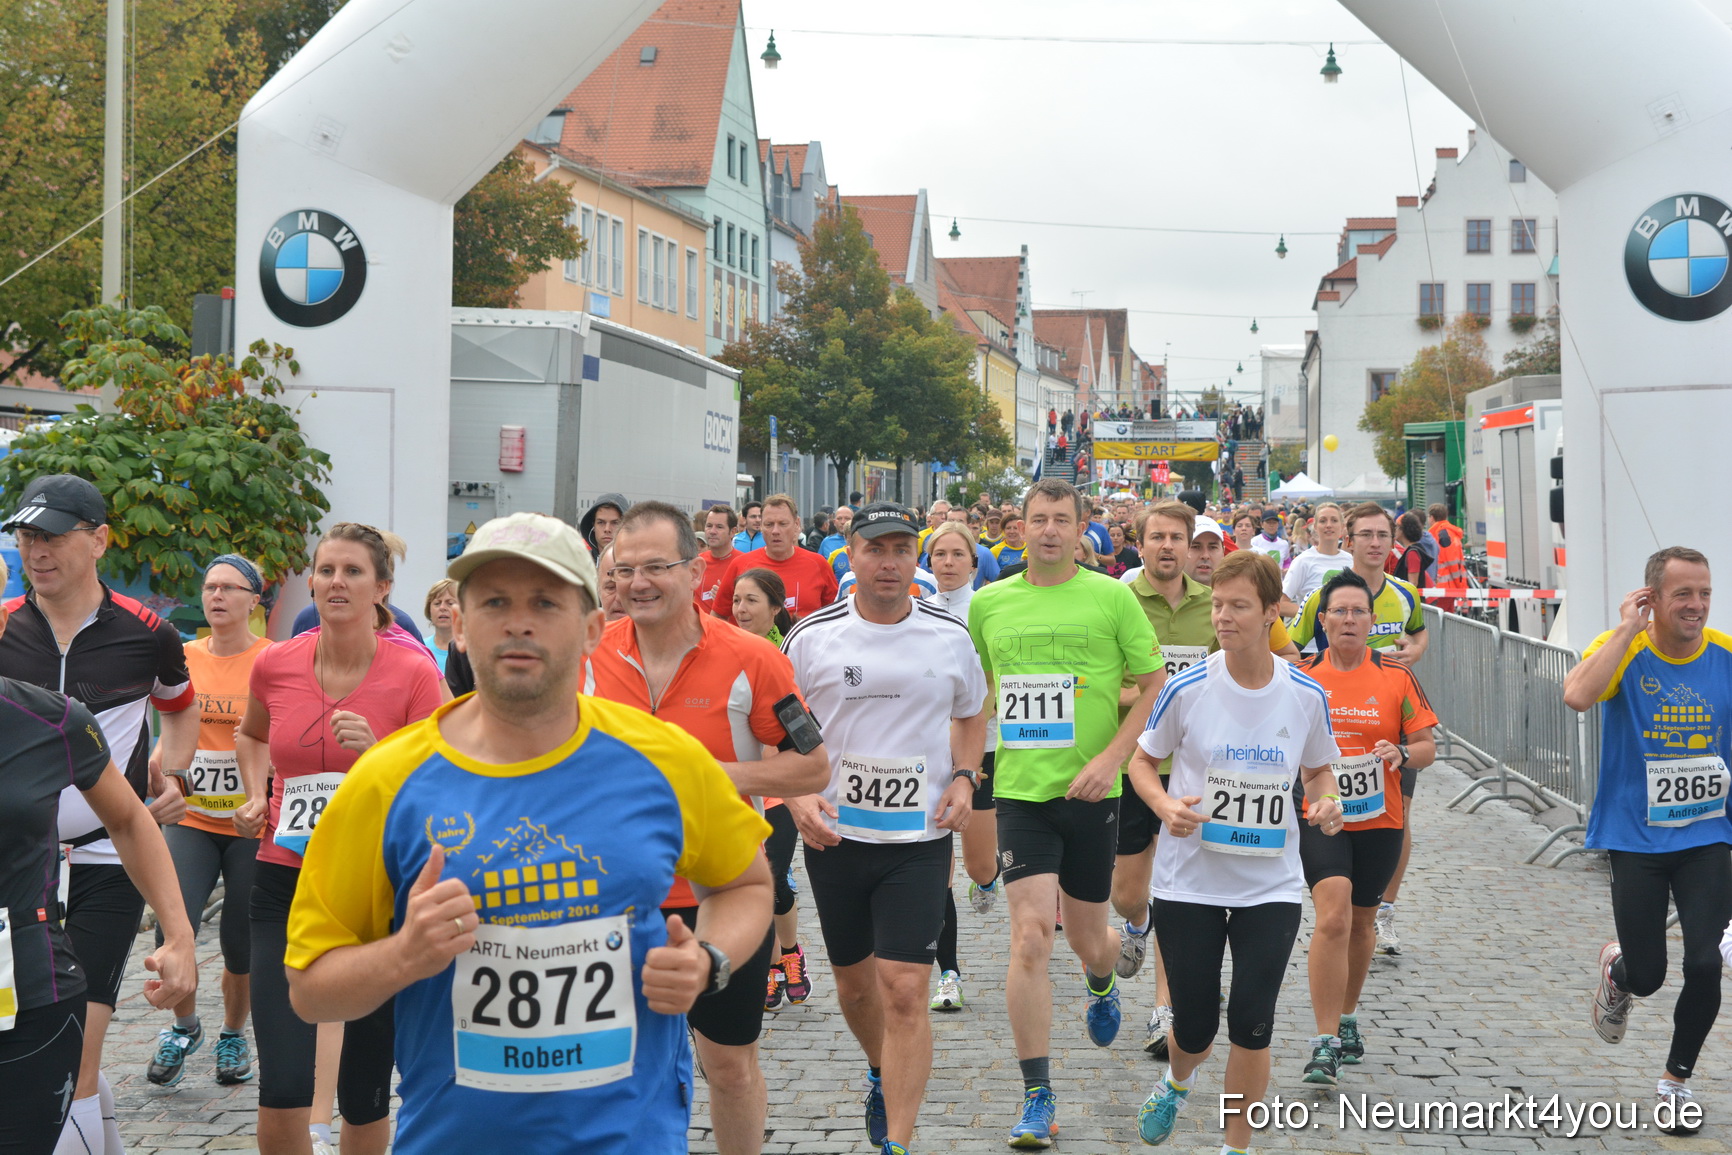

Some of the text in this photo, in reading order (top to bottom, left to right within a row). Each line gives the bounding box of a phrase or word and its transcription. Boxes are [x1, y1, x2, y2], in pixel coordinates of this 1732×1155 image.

[1635, 196, 1732, 240] BMW
[267, 212, 359, 252] BMW
[704, 410, 733, 454] BOCK
[1134, 445, 1178, 456] START
[1369, 622, 1403, 636] OCK
[1168, 651, 1199, 659] Neumarkt
[1023, 681, 1059, 689] Neumarkt
[1005, 692, 1064, 719] 2111
[1018, 727, 1049, 738] Armin
[1226, 744, 1284, 763] heinloth
[842, 759, 913, 774] PARTL Neumarkt
[1341, 759, 1374, 770] Neumarkt
[1649, 764, 1716, 775] PARTL Neumarkt
[285, 784, 314, 796] PARTL
[1208, 775, 1280, 791] PARTL Neumarkt
[1657, 774, 1723, 803] 2865
[846, 774, 920, 808] 3422
[200, 797, 234, 809] Monika
[1212, 790, 1284, 825] 2110
[1343, 801, 1369, 815] Birgit
[286, 796, 328, 831] 28
[1668, 805, 1709, 818] Andreas
[443, 817, 456, 826] 15
[437, 828, 466, 839] Jahre
[1230, 831, 1261, 845] Anita
[567, 904, 600, 918] 2014
[470, 938, 600, 960] ARTL Neumarkt
[471, 961, 616, 1029] 2872
[503, 1043, 583, 1069] Robert
